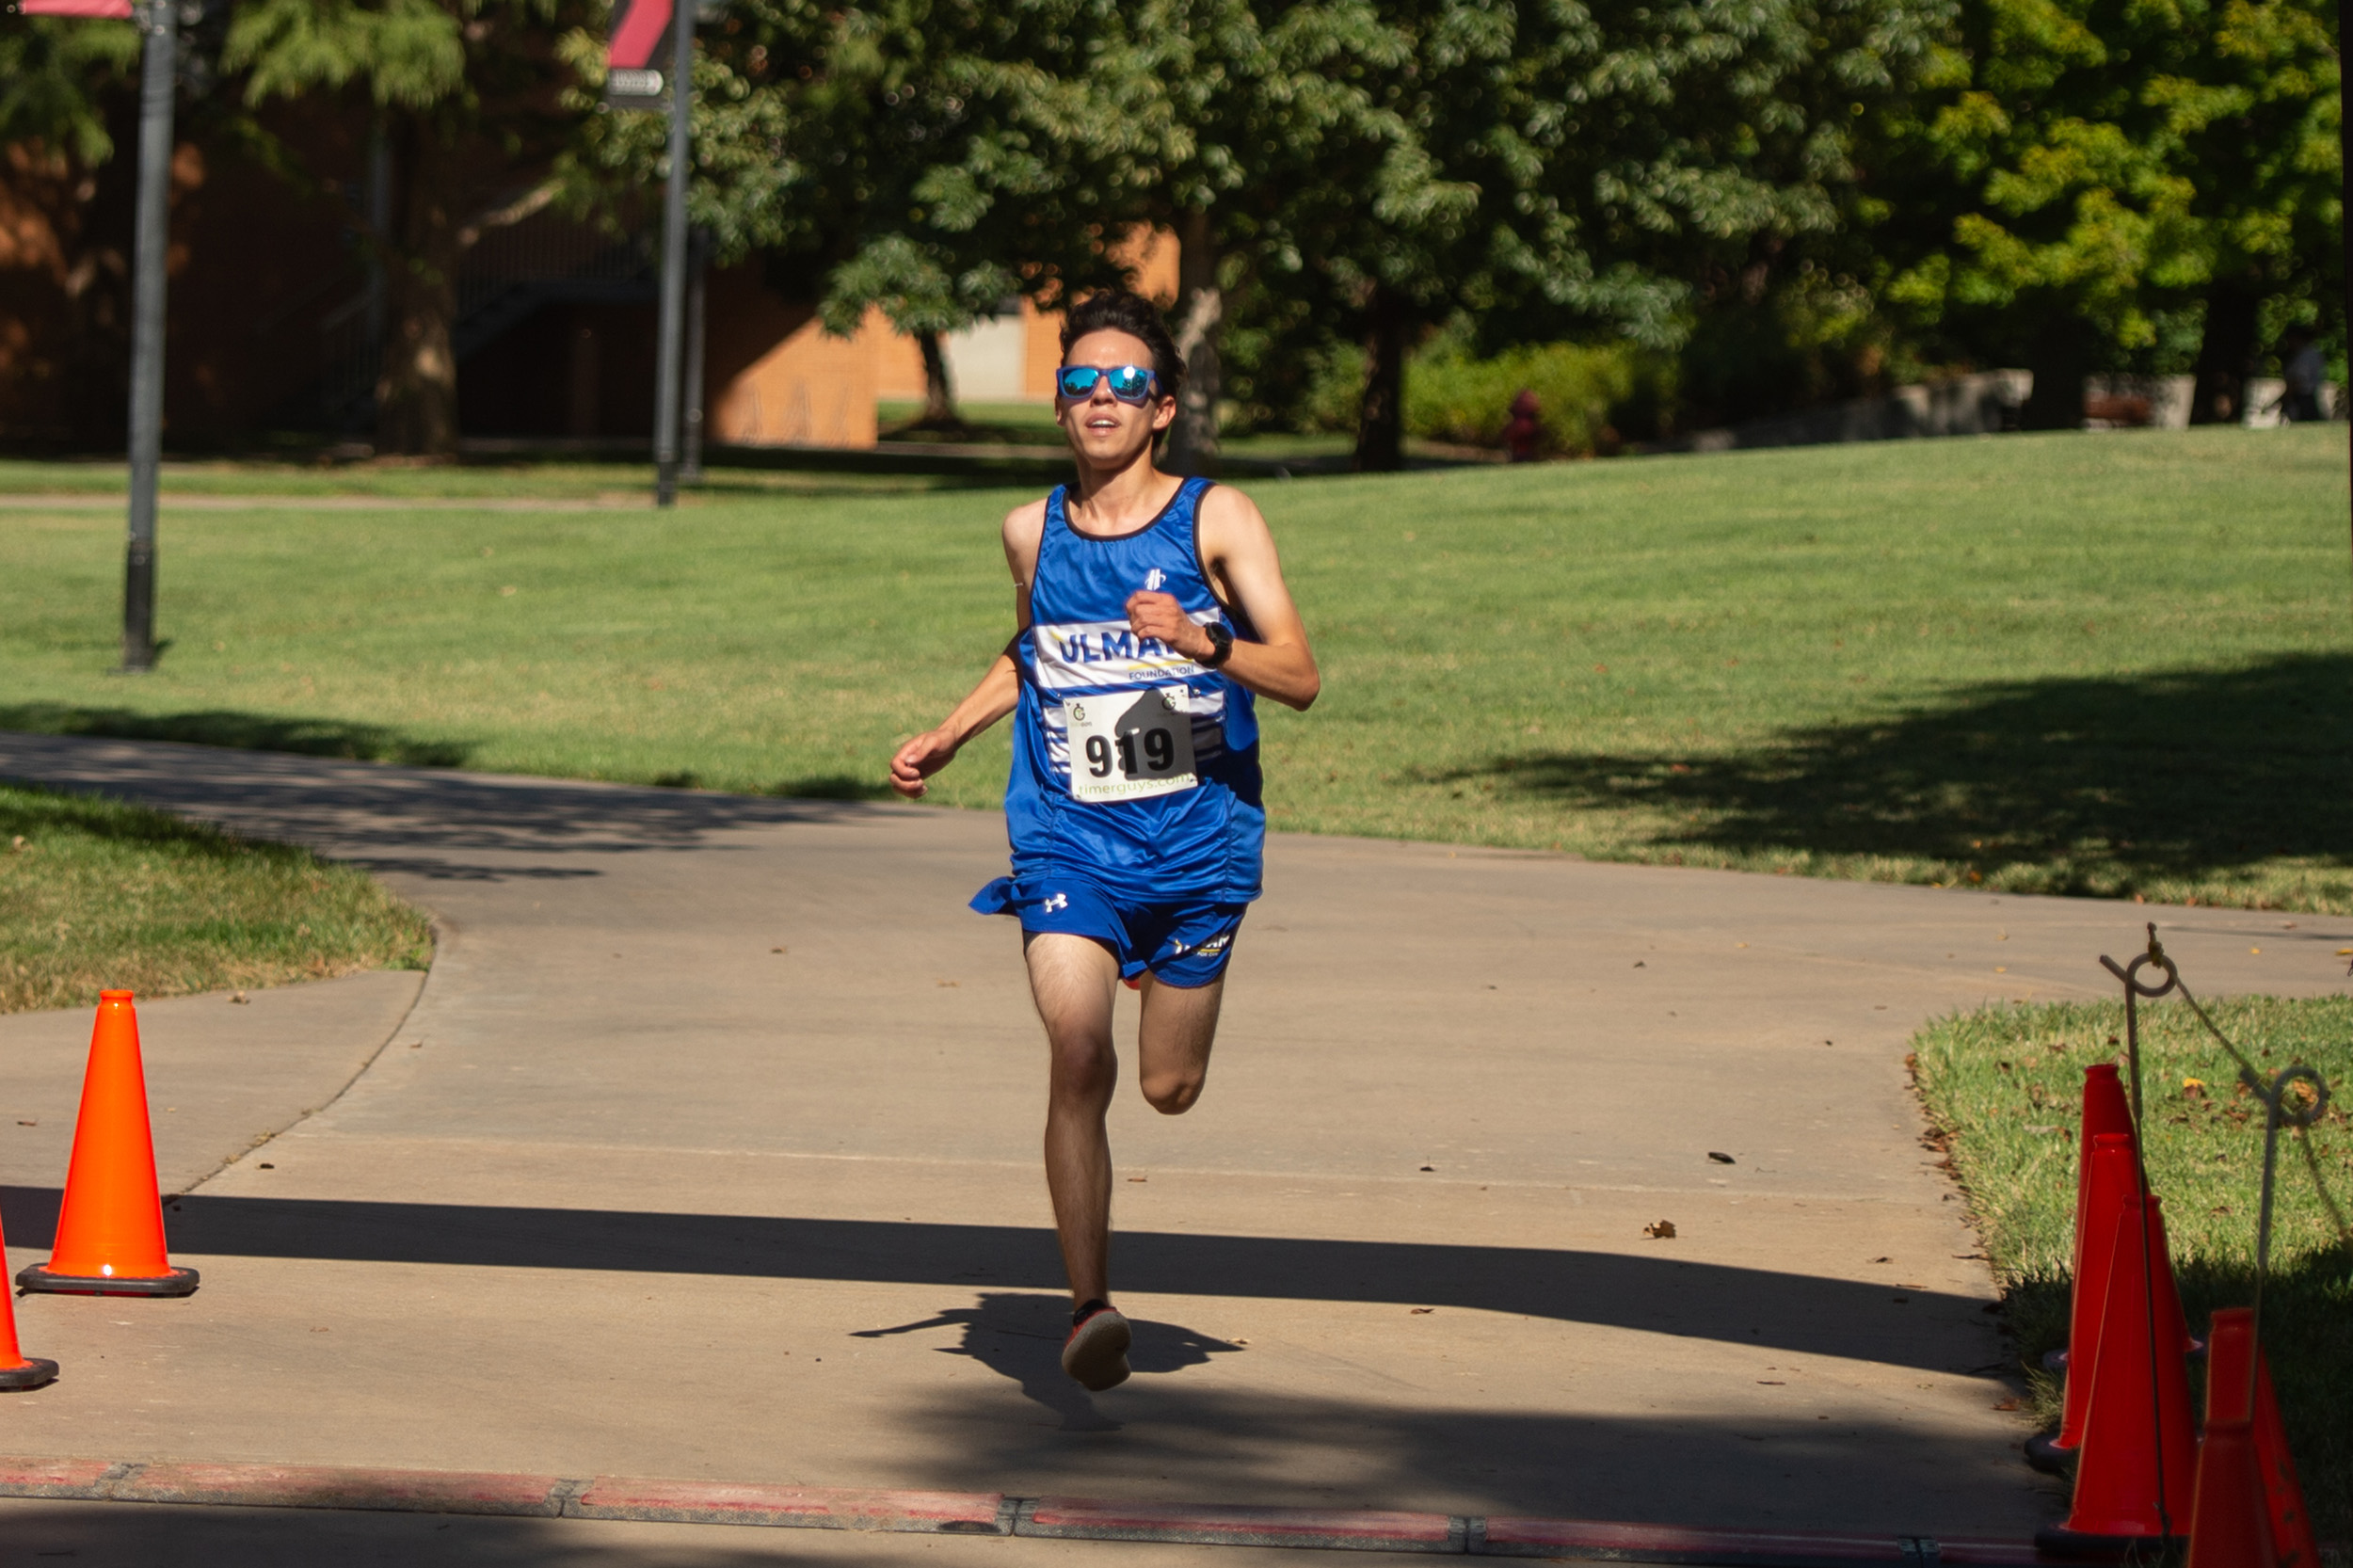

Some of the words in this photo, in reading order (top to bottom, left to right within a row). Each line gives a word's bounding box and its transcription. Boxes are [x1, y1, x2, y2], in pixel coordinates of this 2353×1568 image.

[1059, 630, 1175, 664] ULMA
[1085, 728, 1175, 778] 919
[1079, 773, 1191, 795] timerguys.com
